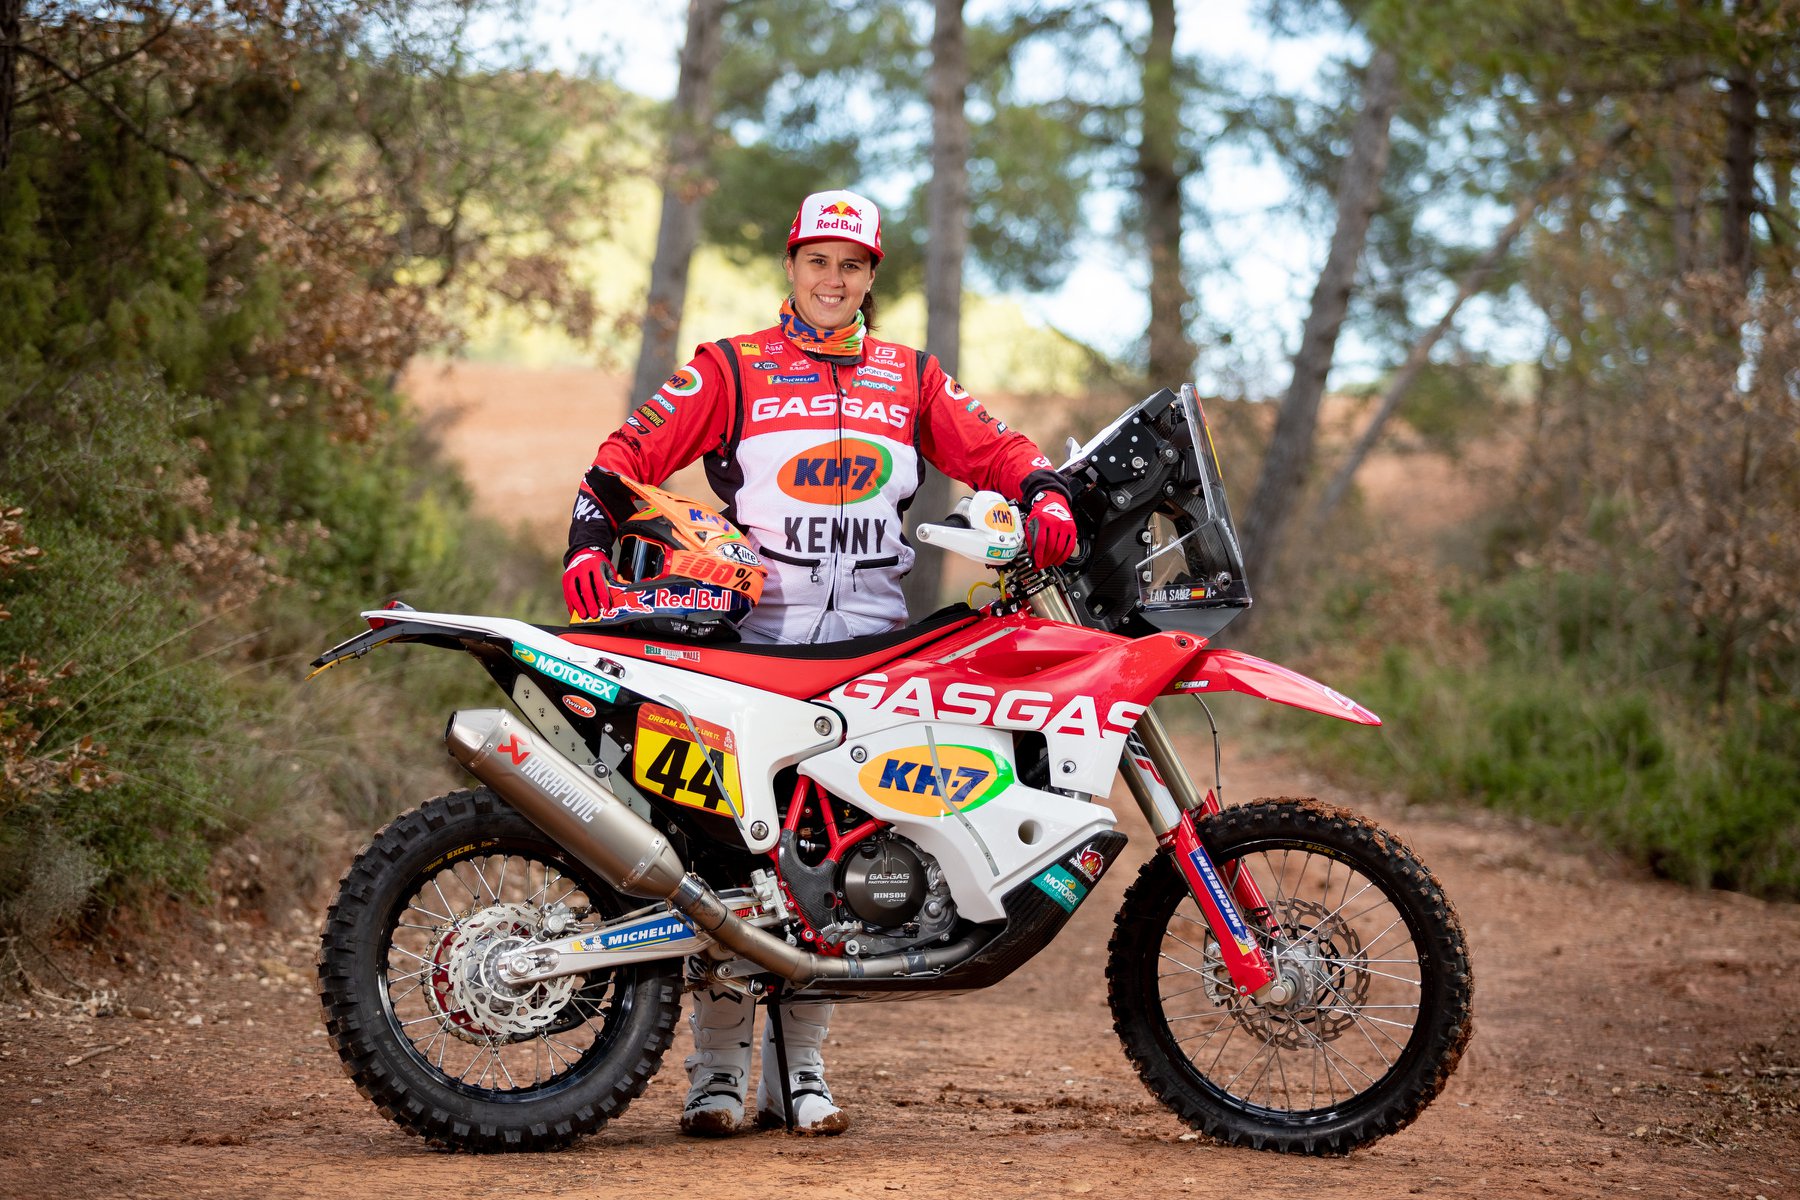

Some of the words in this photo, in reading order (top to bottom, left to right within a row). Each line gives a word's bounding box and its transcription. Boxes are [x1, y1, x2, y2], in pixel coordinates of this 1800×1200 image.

[816, 219, 839, 230] Red
[840, 219, 862, 234] Bull
[869, 356, 906, 368] GASGAS
[752, 394, 910, 428] GASGAS
[784, 516, 887, 554] KENNY
[730, 544, 756, 562] X-lite
[675, 554, 753, 591] 100%
[655, 588, 695, 608] Red
[697, 588, 731, 611] Bull
[1150, 589, 1167, 602] LAIA
[1169, 588, 1190, 601] SANZ
[536, 654, 614, 699] MOTOREX
[565, 697, 581, 710] Twin
[581, 706, 593, 715] Air
[829, 673, 1147, 739] GASGAS
[648, 714, 678, 728] DREAM.
[679, 722, 700, 734] DAE.
[701, 729, 713, 738] LIVE
[645, 737, 727, 810] 44
[446, 843, 476, 860] EXCEL
[1043, 873, 1079, 905] MOTOREX
[1196, 855, 1242, 928] MICHELIN
[608, 923, 684, 946] MICHELIN
